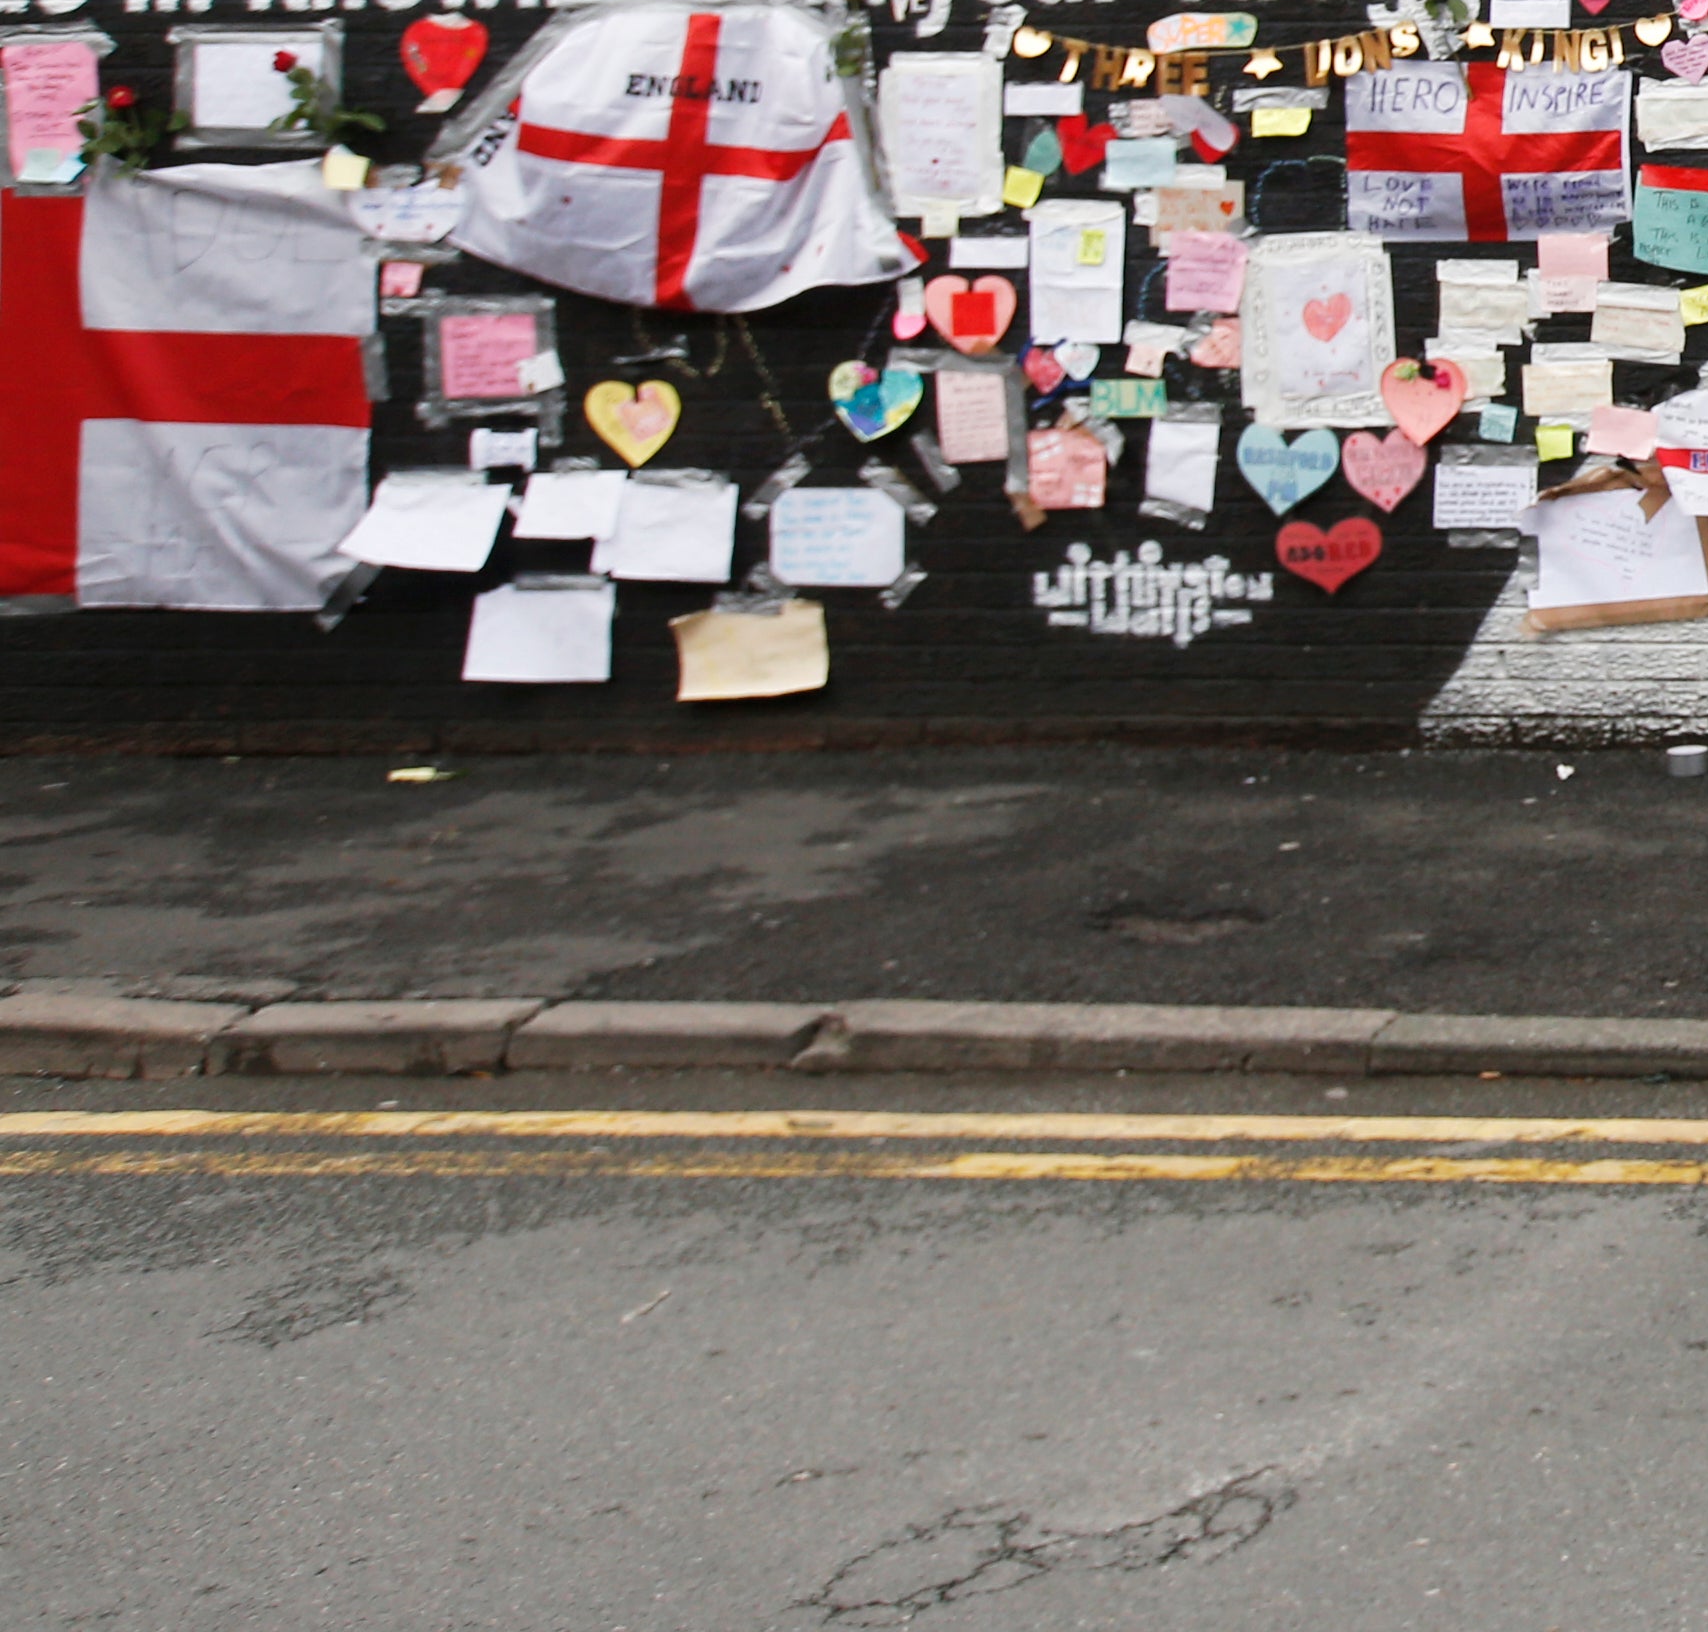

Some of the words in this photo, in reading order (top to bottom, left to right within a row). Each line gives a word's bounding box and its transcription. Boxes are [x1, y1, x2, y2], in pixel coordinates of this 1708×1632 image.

[1057, 39, 1210, 98] THREE
[1303, 20, 1421, 88] LIONS
[1496, 23, 1625, 73] KING!
[1369, 77, 1461, 114] HERO
[1507, 78, 1606, 114] INSPIRE
[1363, 174, 1433, 194] LOVE
[1383, 195, 1430, 214] NOT
[1092, 382, 1168, 415] BLM
